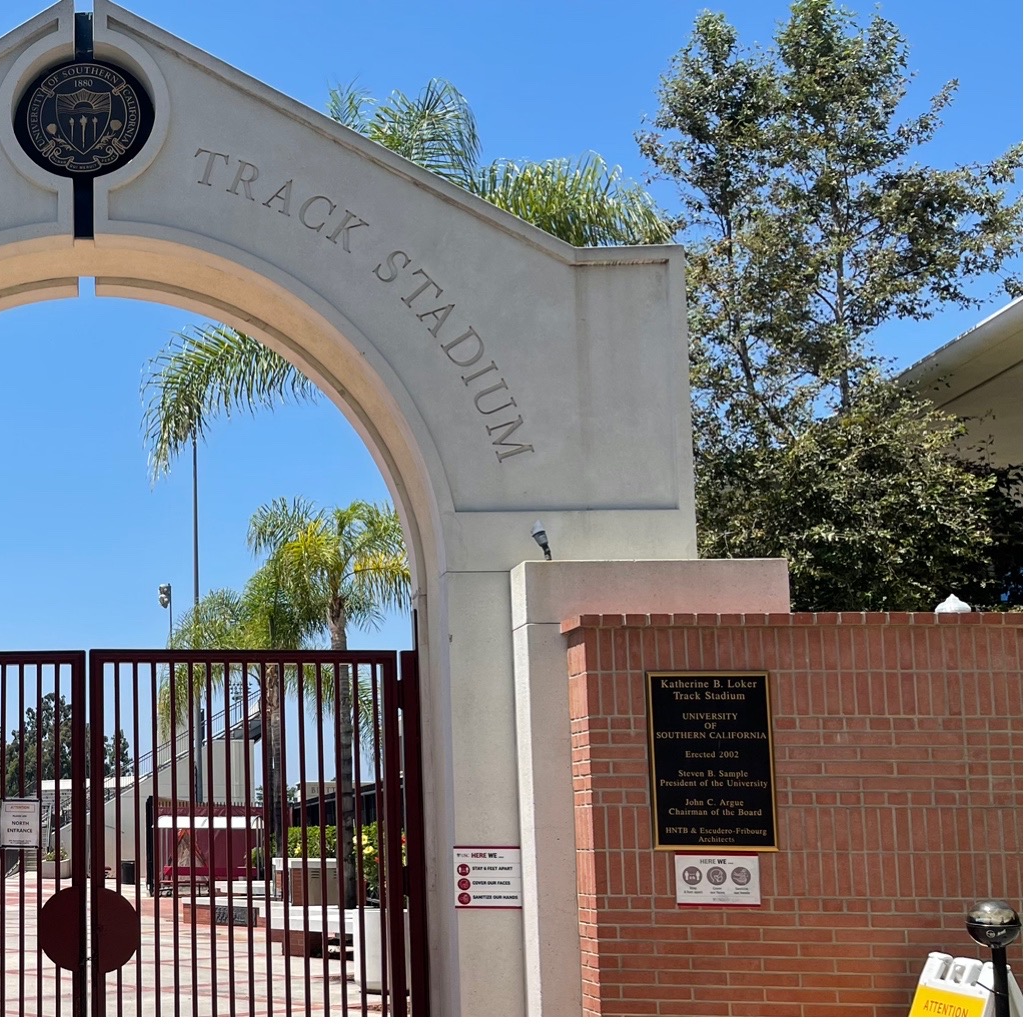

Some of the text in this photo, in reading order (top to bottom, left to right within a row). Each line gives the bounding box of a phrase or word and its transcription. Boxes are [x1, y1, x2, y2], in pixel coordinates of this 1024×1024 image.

[74, 79, 93, 88] 1880
[31, 66, 137, 147] UNIVERSITY OF SOUTHERN CALIFORNIA
[194, 148, 370, 253] TRACK
[372, 250, 535, 464] STADIUM
[660, 679, 758, 689] Katherine B. Loker
[673, 691, 746, 700] Track Stadium
[704, 722, 717, 730] OF
[685, 750, 739, 759] Erected 2002
[678, 770, 749, 780] Steven B. Sample
[660, 779, 769, 789] President of the University
[685, 799, 744, 808] John C. Argue
[668, 808, 763, 816] Chairman of the Board
[699, 827, 768, 836] Escudero-Fribourg
[923, 1000, 969, 1017] ATTENTION
